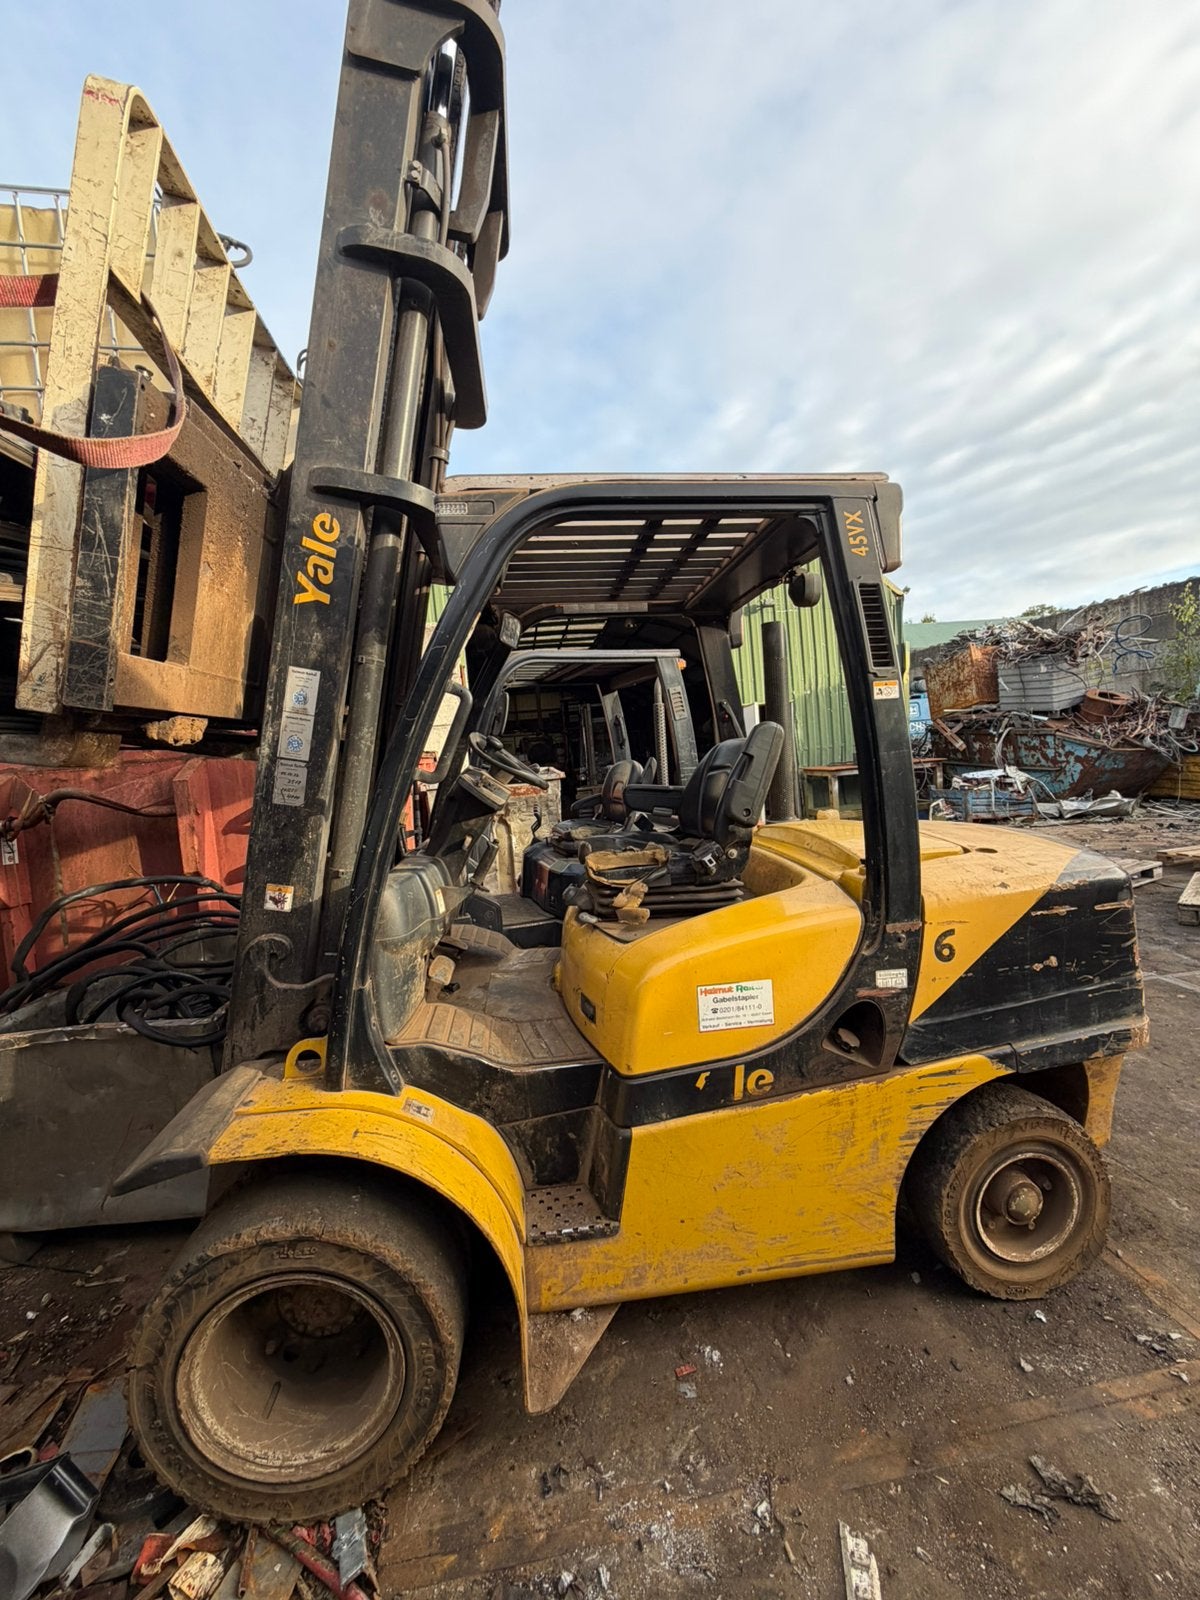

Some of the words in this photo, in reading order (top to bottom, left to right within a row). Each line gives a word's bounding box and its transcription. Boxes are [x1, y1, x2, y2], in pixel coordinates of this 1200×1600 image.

[843, 509, 869, 557] 45VX
[293, 512, 341, 605] Yale
[933, 927, 956, 963] 6
[712, 993, 759, 1004] Gabelstapler
